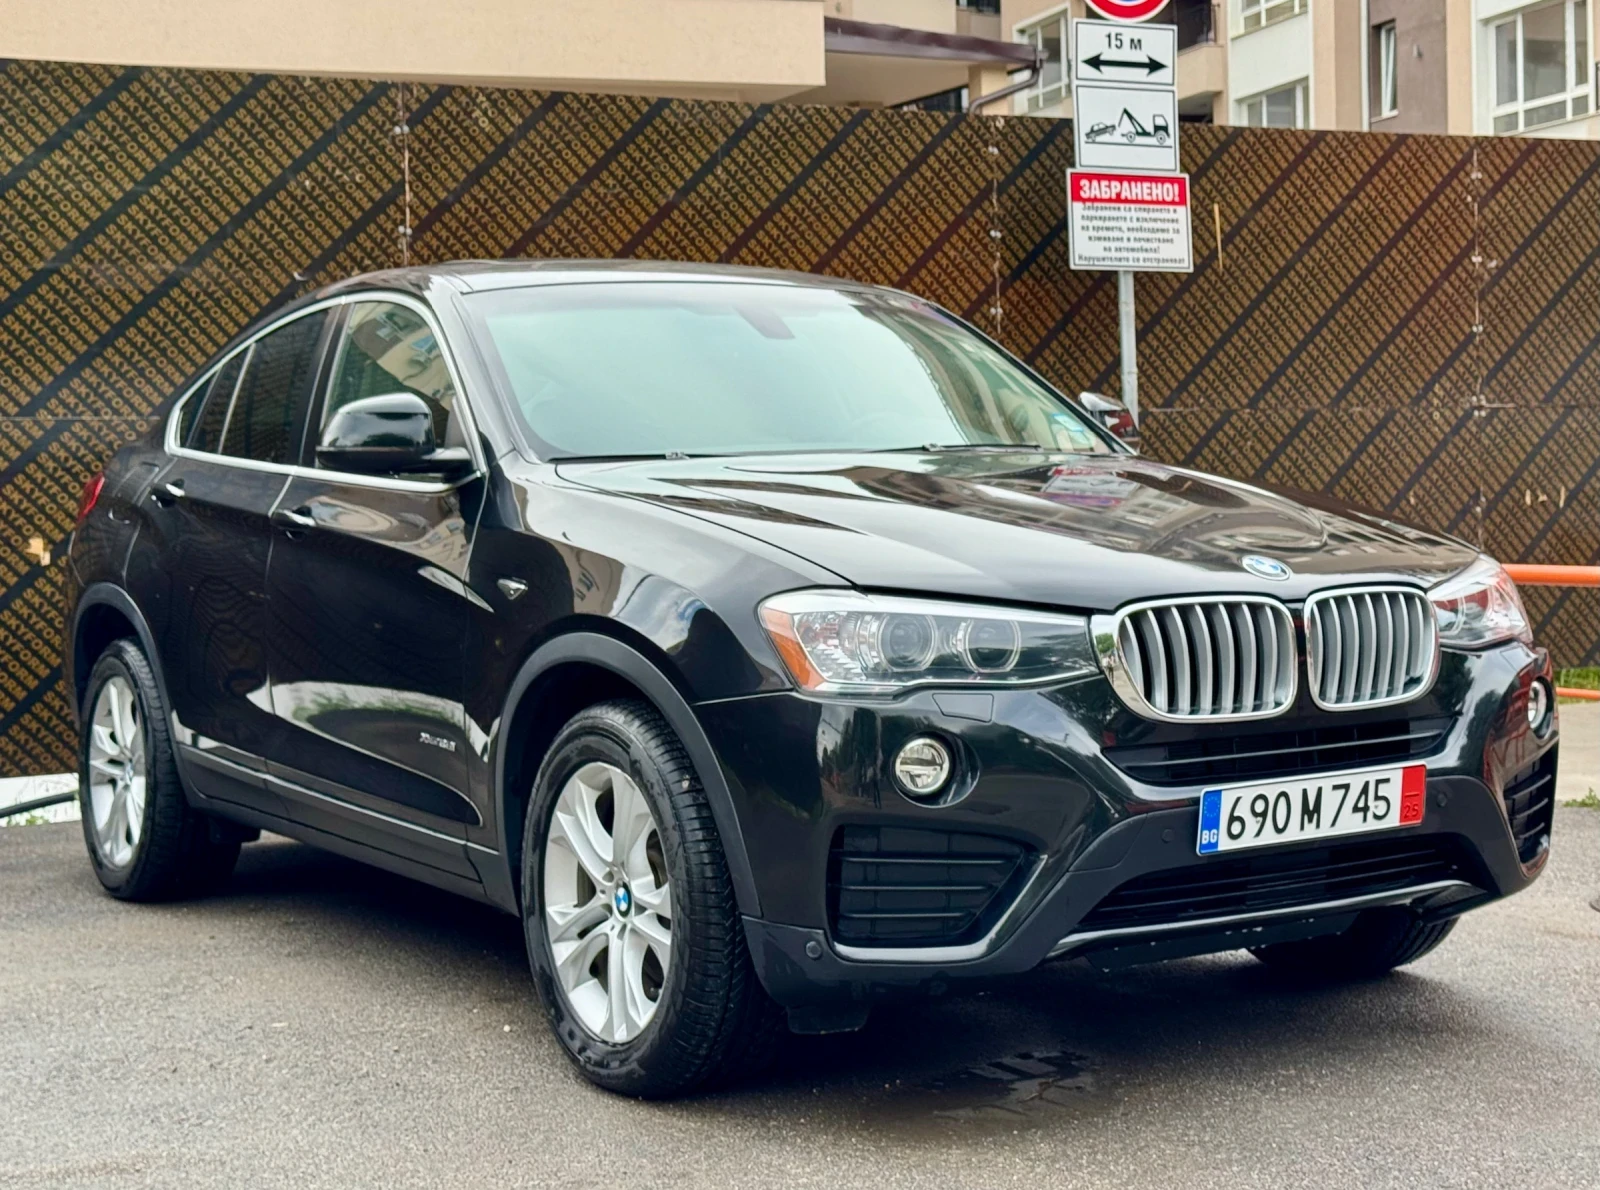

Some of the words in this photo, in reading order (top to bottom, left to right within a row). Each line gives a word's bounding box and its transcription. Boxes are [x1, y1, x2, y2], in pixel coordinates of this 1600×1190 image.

[1105, 32, 1124, 50] 15
[6, 62, 72, 126] SKYFORM
[117, 90, 180, 153] SKYFORM
[129, 80, 191, 143] SKYFORM
[140, 71, 202, 134] SKYFORM
[267, 79, 326, 141] SKYFORM
[562, 92, 615, 149] SKYFORM
[73, 128, 137, 191] SKYFORM
[84, 119, 148, 182] SKYFORM
[95, 109, 159, 172] SKYFORM
[106, 99, 170, 162] SKYFORM
[214, 126, 274, 187] SKYFORM
[235, 107, 295, 169] SKYFORM
[412, 123, 468, 181] SKYFORM
[422, 114, 478, 172] SKYFORM
[431, 105, 487, 163] SKYFORM
[525, 128, 579, 185] SKYFORM
[535, 119, 588, 176] SKYFORM
[544, 110, 597, 167] SKYFORM
[553, 101, 606, 158] SKYFORM
[652, 115, 703, 171] SKYFORM
[763, 112, 812, 166] SKYFORM
[862, 117, 909, 170] SKYFORM
[39, 158, 103, 221] SKYFORM
[50, 148, 115, 211] SKYFORM
[61, 138, 126, 201] SKYFORM
[181, 155, 243, 216] SKYFORM
[192, 145, 253, 206] SKYFORM
[327, 142, 385, 202] SKYFORM
[498, 155, 552, 212] SKYFORM
[507, 146, 561, 203] SKYFORM
[516, 137, 570, 194] SKYFORM
[625, 142, 677, 198] SKYFORM
[738, 138, 787, 192] SKYFORM
[830, 151, 877, 204] SKYFORM
[846, 134, 893, 187] SKYFORM
[918, 163, 964, 215] SKYFORM
[942, 138, 987, 190] SKYFORM
[1080, 179, 1180, 202] ЗАБРАНЕНО!
[4, 187, 70, 250] SKYFORM
[16, 177, 81, 240] SKYFORM
[27, 167, 92, 231] SKYFORM
[149, 183, 211, 245] SKYFORM
[160, 174, 222, 235] SKYFORM
[171, 164, 232, 226] SKYFORM
[296, 170, 355, 230] SKYFORM
[460, 192, 515, 249] SKYFORM
[469, 183, 524, 240] SKYFORM
[479, 174, 534, 231] SKYFORM
[488, 165, 543, 222] SKYFORM
[580, 187, 633, 242] SKYFORM
[598, 169, 651, 224] SKYFORM
[687, 190, 737, 245] SKYFORM
[712, 164, 762, 218] SKYFORM
[788, 194, 837, 247] SKYFORM
[813, 168, 861, 221] SKYFORM
[902, 180, 948, 232] SKYFORM
[1081, 215, 1128, 223] паркирането
[105, 222, 168, 284] SKYFORM
[116, 213, 179, 274] SKYFORM
[127, 203, 189, 264] SKYFORM
[138, 193, 200, 255] SKYFORM
[265, 199, 324, 259] SKYFORM
[450, 202, 506, 259] SKYFORM
[571, 196, 624, 252] SKYFORM
[772, 211, 821, 264] SKYFORM
[862, 222, 909, 275] SKYFORM
[878, 205, 925, 258] SKYFORM
[1127, 226, 1170, 234] необходимо
[71, 252, 135, 314] SKYFORM
[82, 242, 146, 304] SKYFORM
[93, 232, 157, 294] SKYFORM
[201, 256, 262, 316] SKYFORM
[212, 247, 273, 307] SKYFORM
[233, 227, 293, 287] SKYFORM
[25, 292, 90, 354] SKYFORM
[37, 282, 102, 344] SKYFORM
[48, 272, 113, 334] SKYFORM
[60, 262, 124, 324] SKYFORM
[191, 266, 252, 326] SKYFORM
[2, 313, 68, 374] SKYFORM
[14, 302, 79, 364] SKYFORM
[125, 325, 188, 386] SKYFORM
[92, 355, 155, 416] SKYFORM
[103, 345, 166, 406] SKYFORM
[114, 335, 177, 396] SKYFORM
[1, 483, 66, 543] SKYFORM
[12, 473, 77, 532] SKYFORM
[0, 610, 61, 667] SKYFORM
[1202, 830, 1218, 845] BG
[1226, 791, 1292, 840] 690
[1300, 786, 1323, 832] M
[1330, 778, 1391, 828] 745
[1404, 803, 1419, 819] 25
